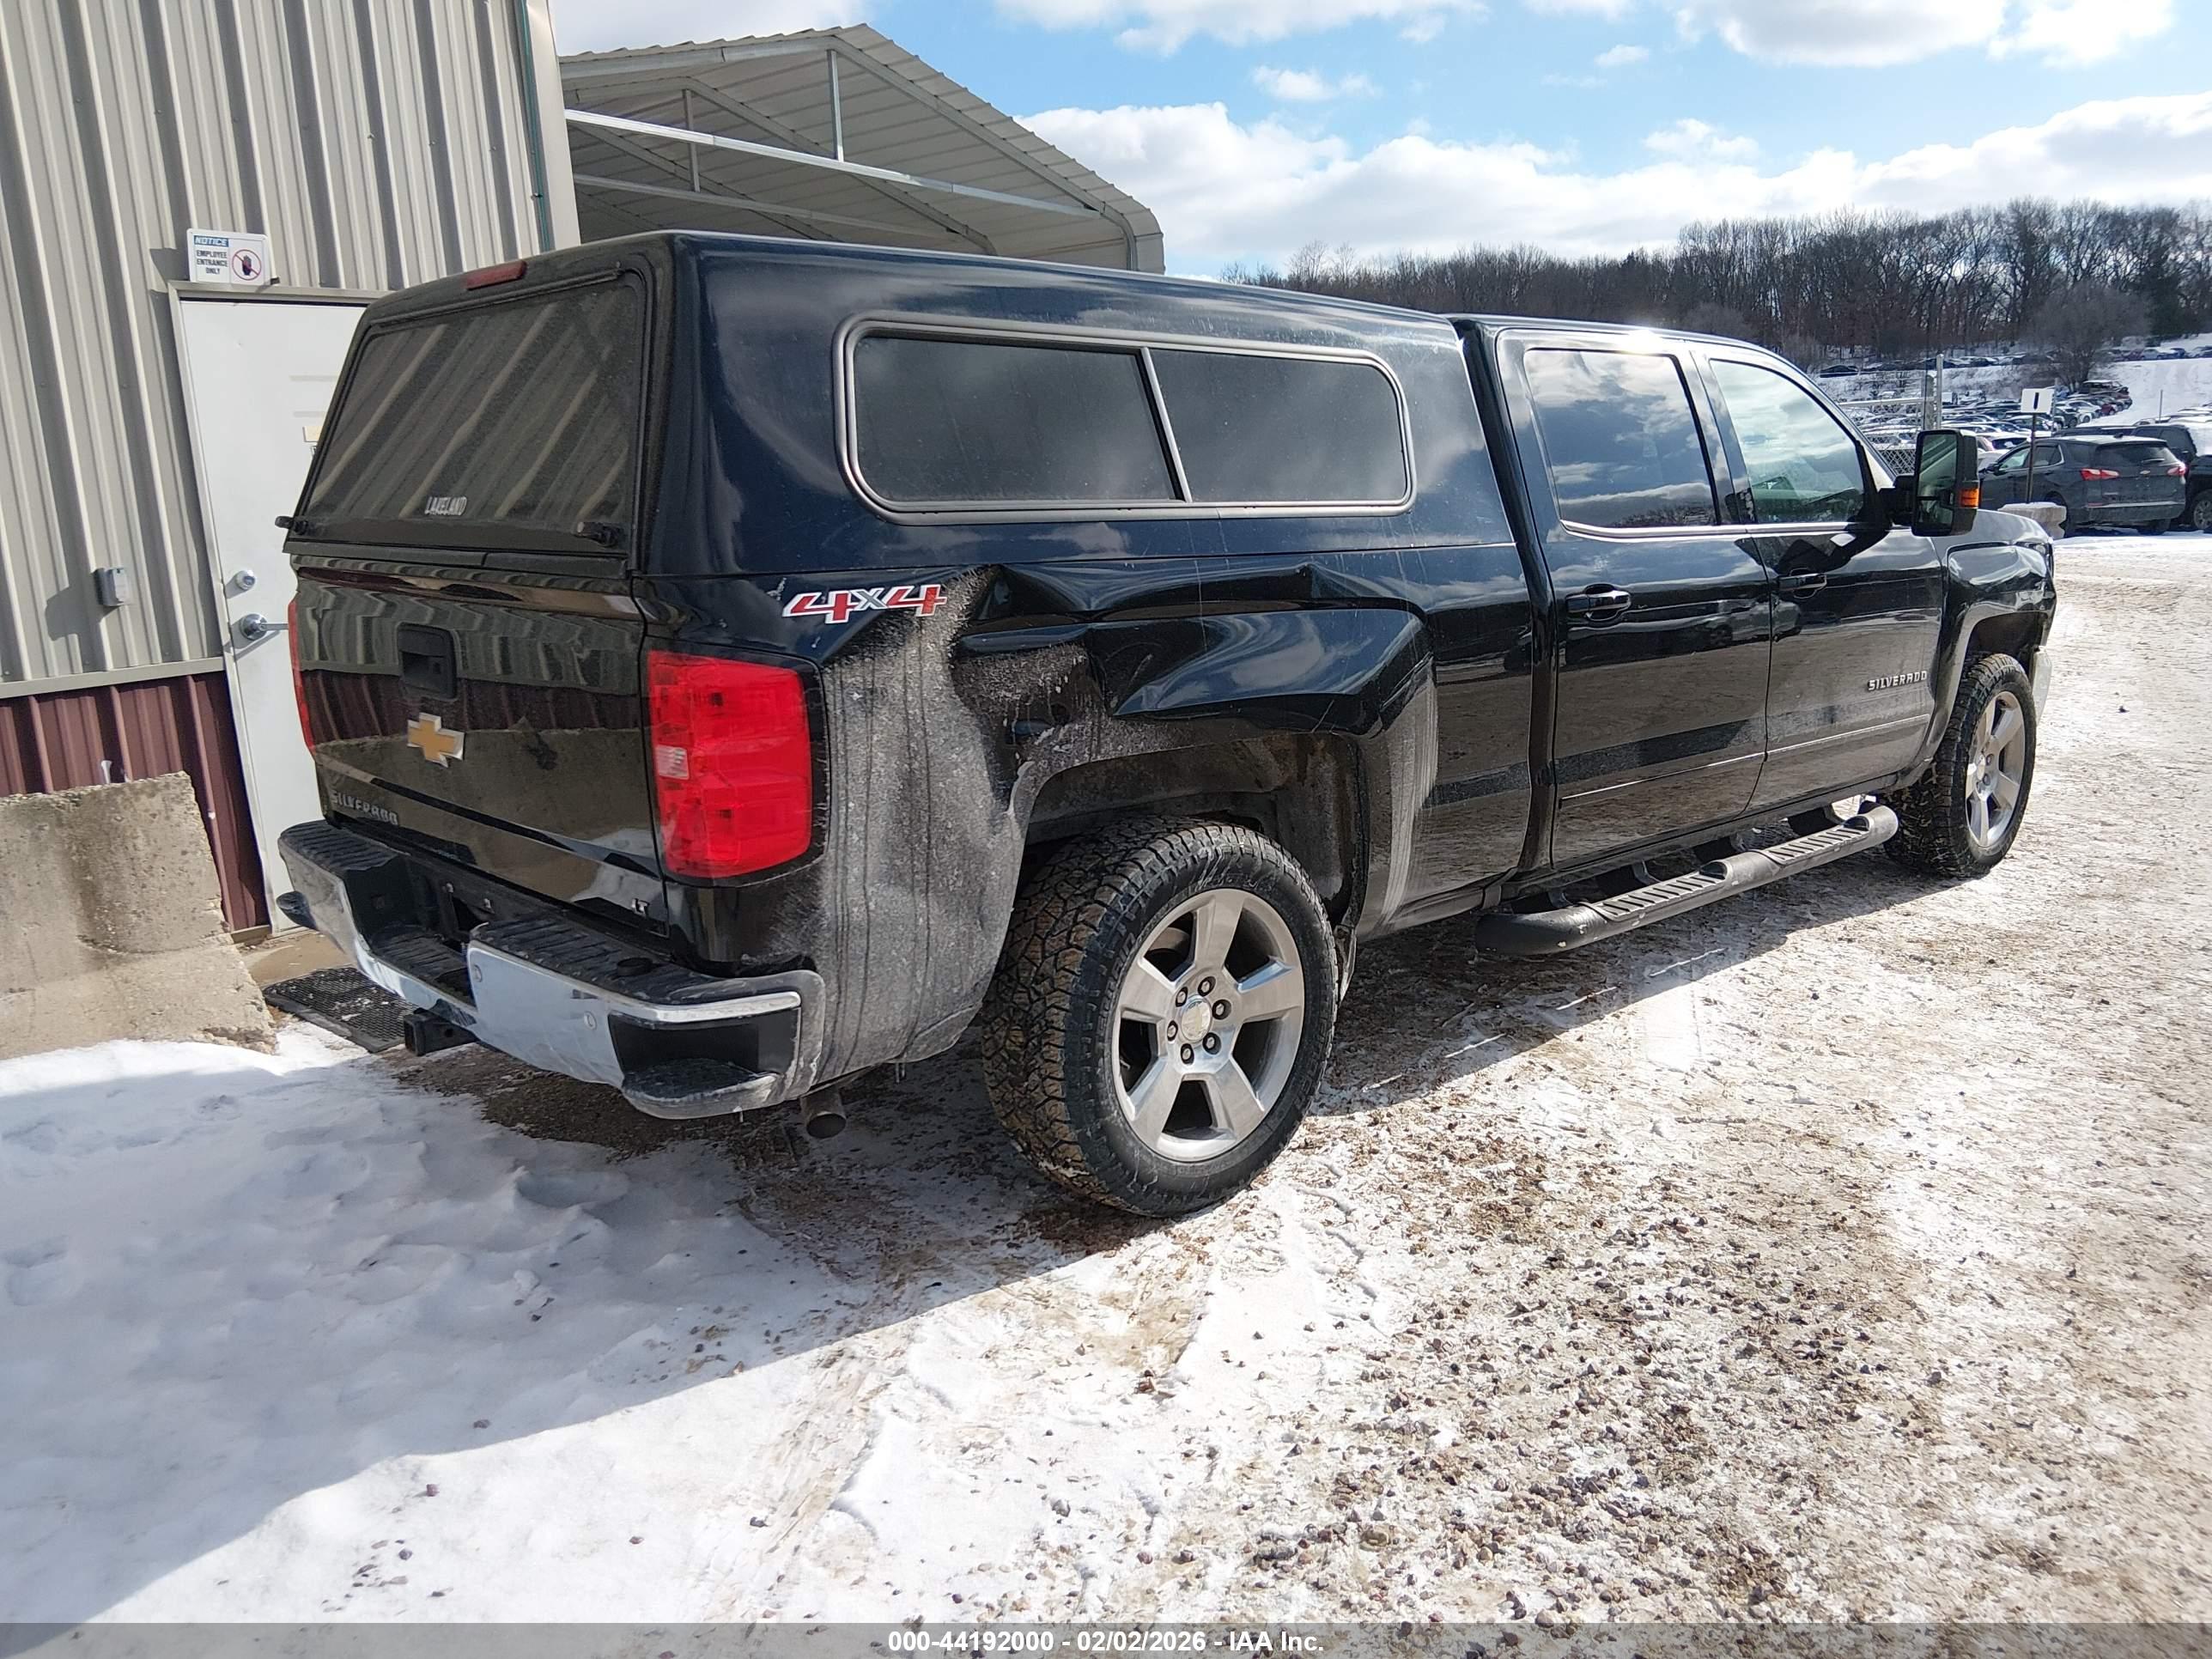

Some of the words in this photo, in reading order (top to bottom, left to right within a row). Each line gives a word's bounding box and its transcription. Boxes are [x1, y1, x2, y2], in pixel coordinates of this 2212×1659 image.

[195, 236, 228, 246] NOTICE
[424, 495, 467, 515] LAKELAND
[1868, 671, 1928, 690] SILVERADO
[331, 791, 398, 824] SILVERADO
